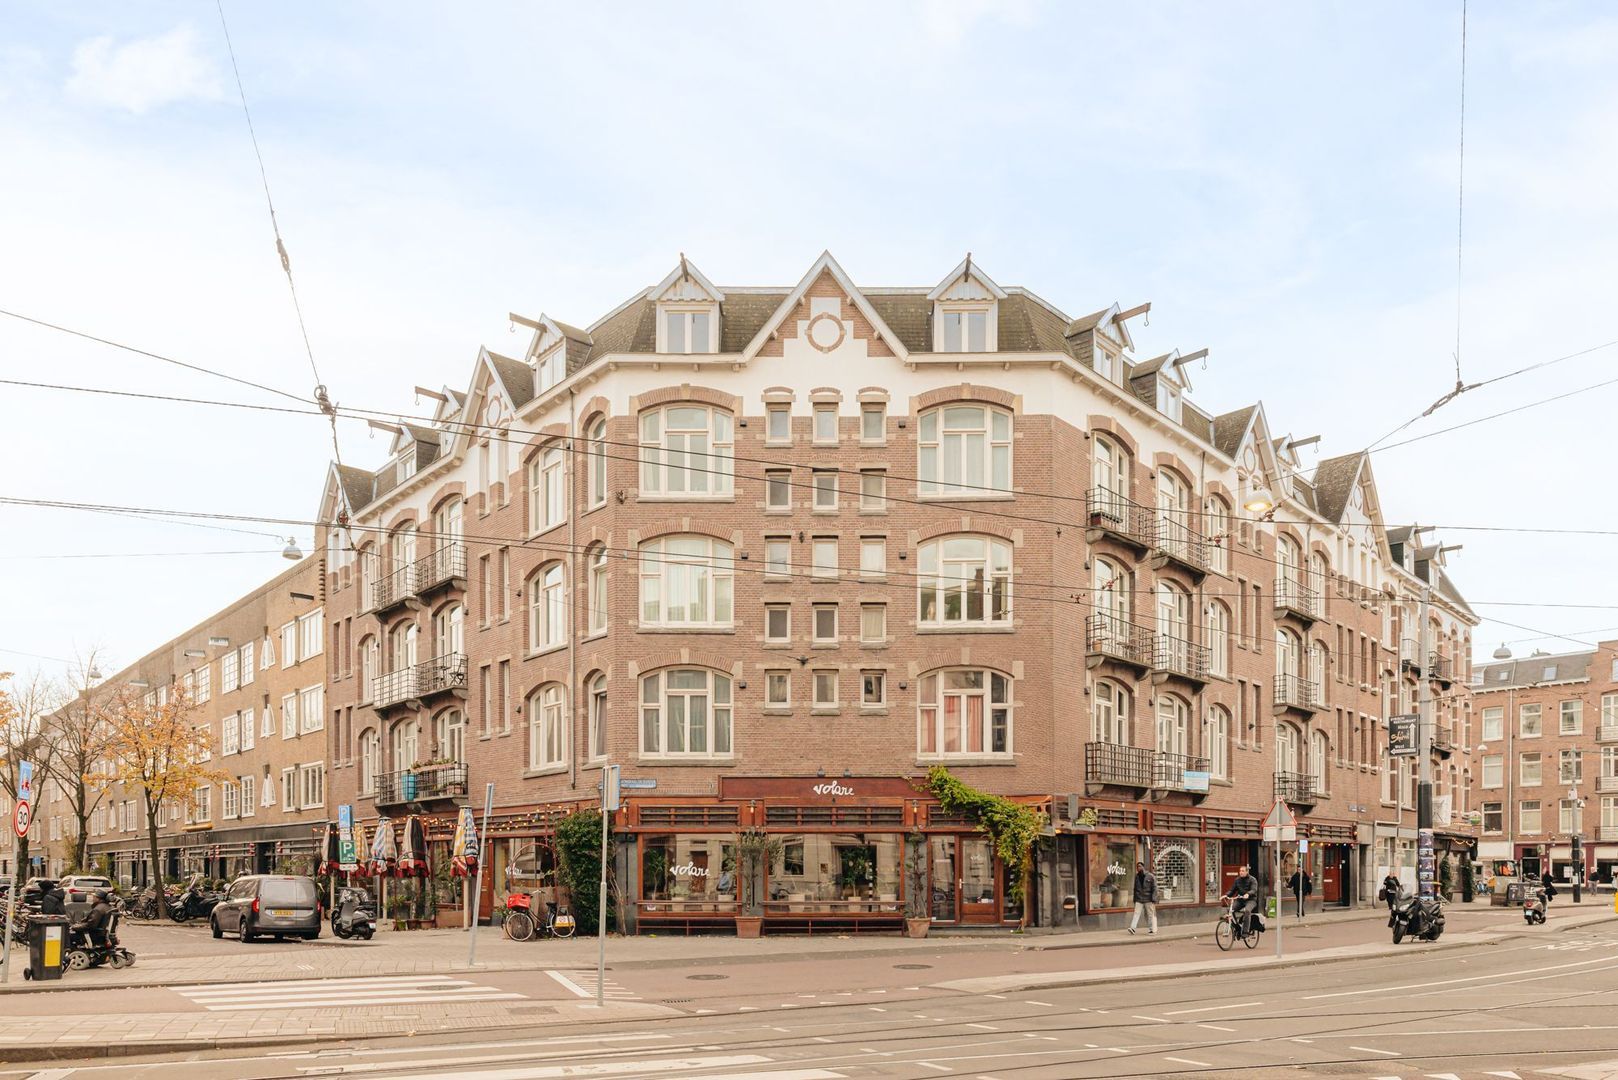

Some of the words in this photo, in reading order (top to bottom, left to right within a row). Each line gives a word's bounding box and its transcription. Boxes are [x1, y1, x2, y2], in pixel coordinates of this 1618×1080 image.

[812, 780, 855, 796] volare
[18, 811, 28, 826] 30
[343, 842, 353, 854] P
[669, 861, 711, 877] volare
